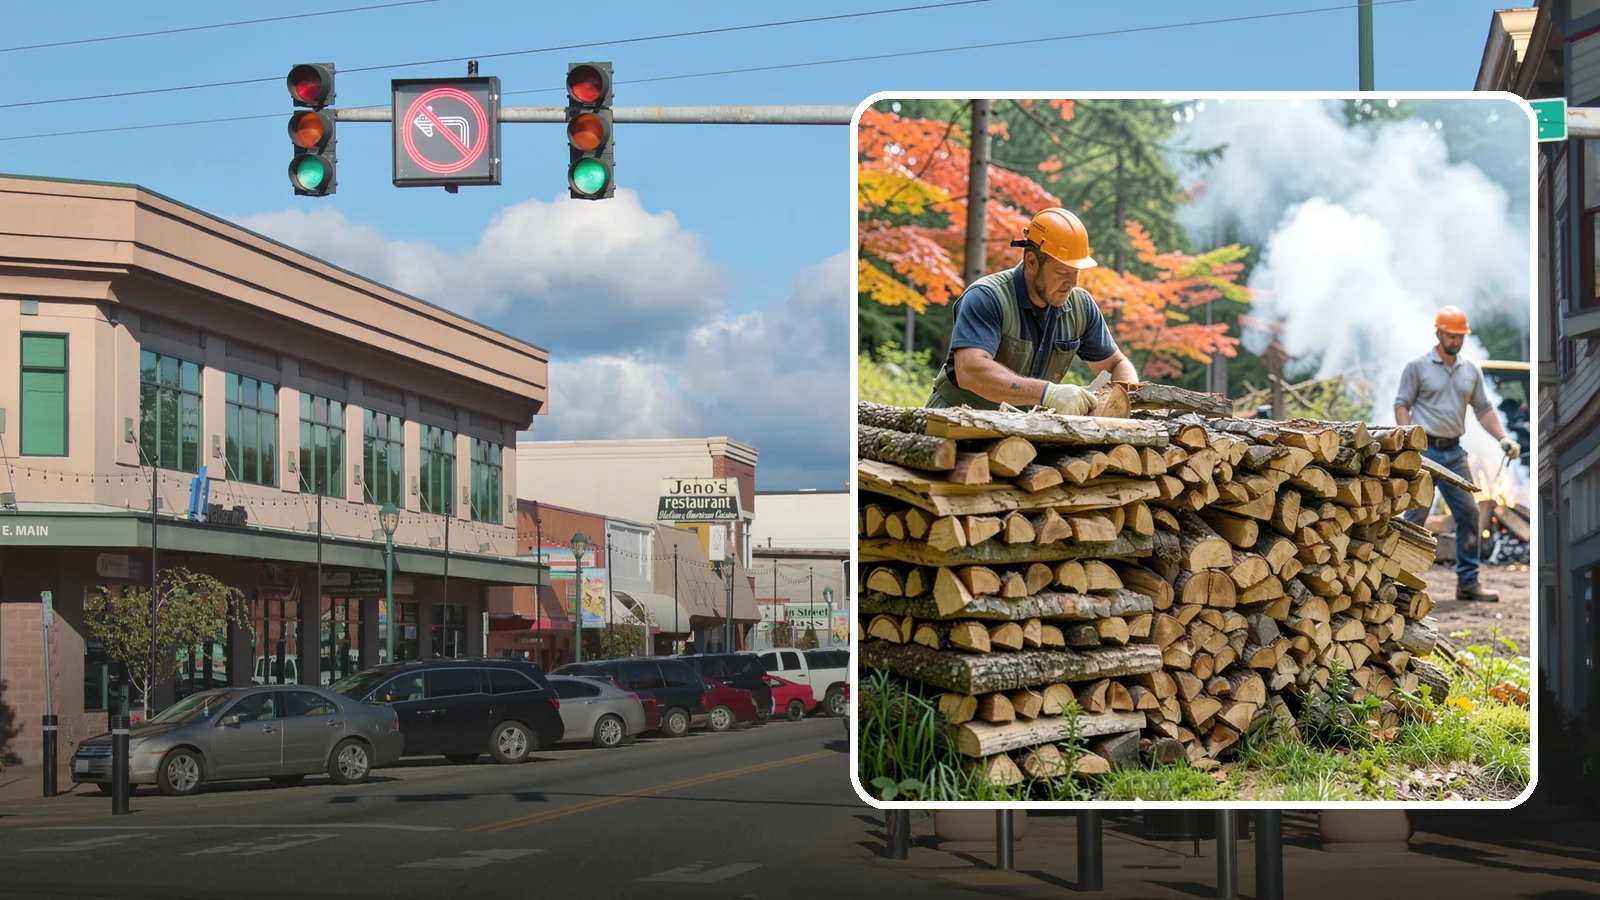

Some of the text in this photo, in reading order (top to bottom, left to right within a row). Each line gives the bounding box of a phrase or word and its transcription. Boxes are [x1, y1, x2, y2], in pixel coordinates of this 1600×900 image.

[669, 480, 727, 495] Jeno's
[665, 496, 731, 509] restaurant
[686, 509, 714, 519] American
[715, 509, 738, 519] Cuisine
[2, 525, 49, 536] E. MAIN
[797, 607, 828, 617] Street
